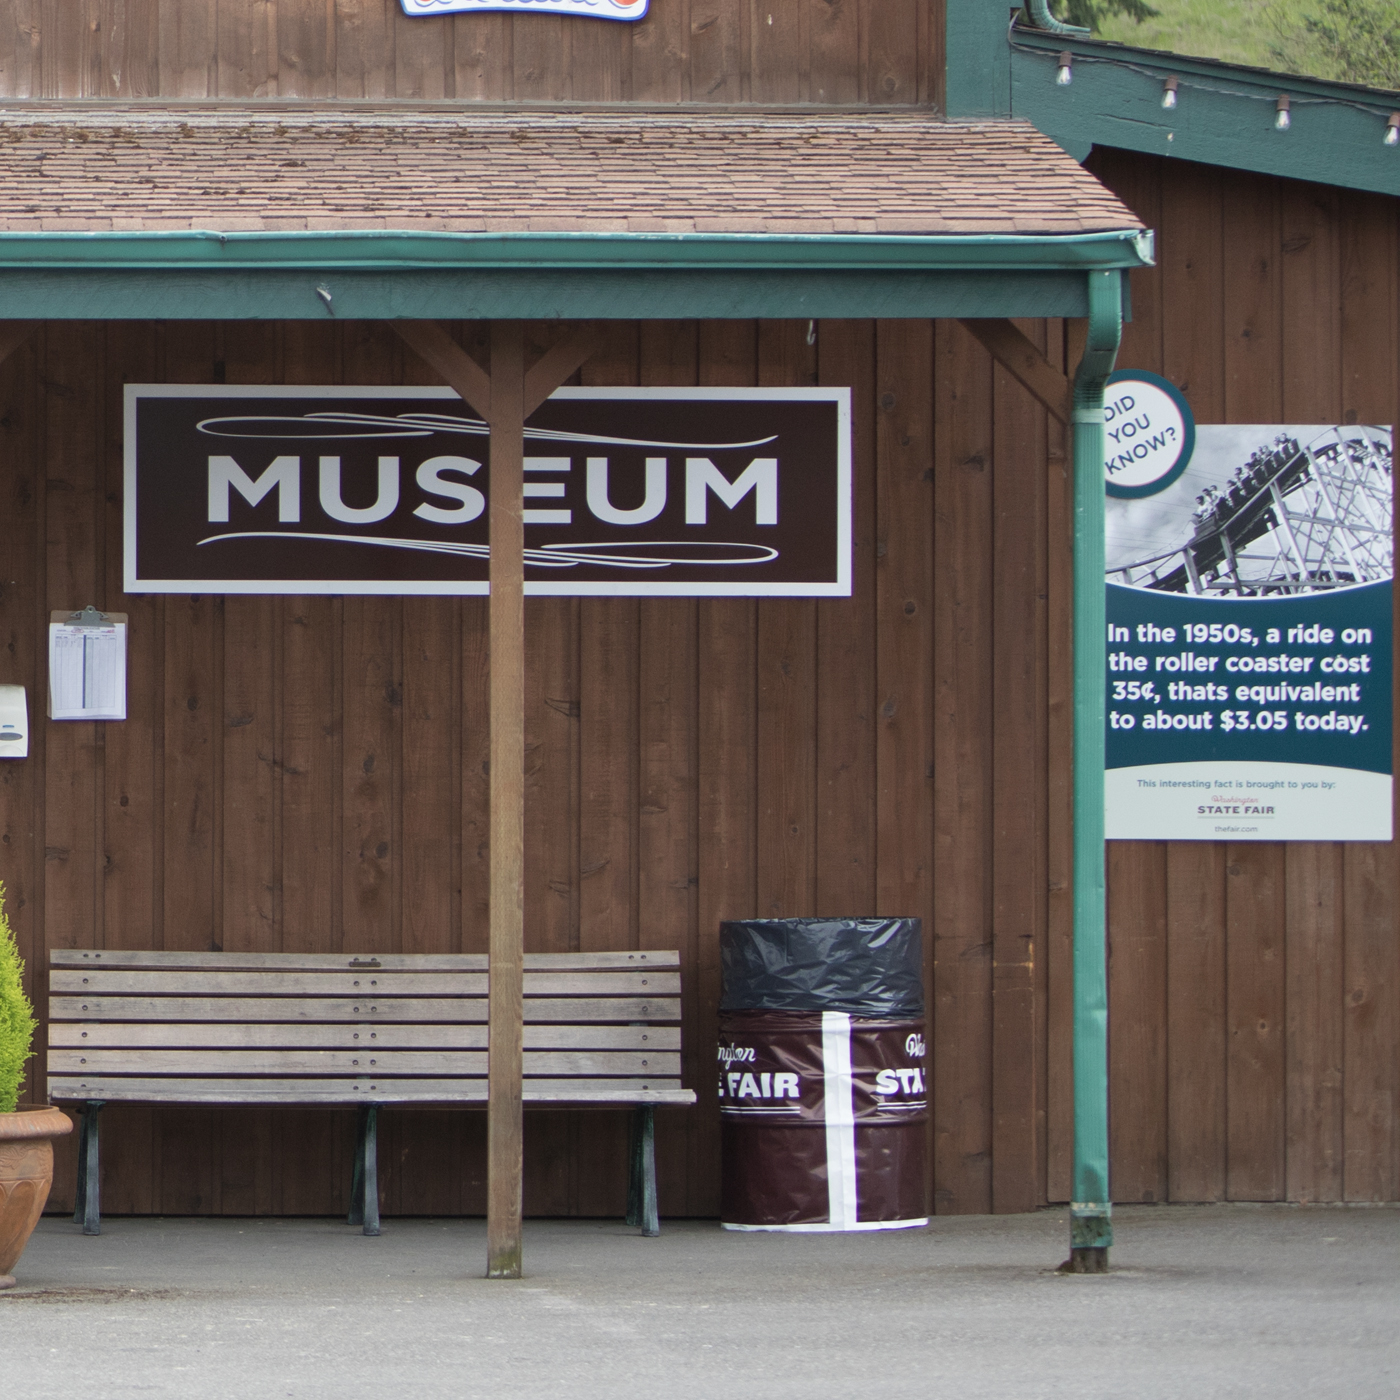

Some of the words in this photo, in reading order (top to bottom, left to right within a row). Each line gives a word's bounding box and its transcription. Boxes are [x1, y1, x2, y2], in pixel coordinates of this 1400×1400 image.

[1104, 395, 1135, 423] DID
[1107, 413, 1150, 444] YOU
[1104, 426, 1176, 475] KNOW?
[207, 455, 778, 525] MUSEUM
[1107, 623, 1129, 642] In
[1136, 623, 1176, 642] the
[1183, 624, 1259, 647] 1950s,
[1265, 628, 1280, 643] a
[1287, 624, 1334, 643] ride
[1341, 628, 1372, 643] on
[1108, 652, 1148, 672] the
[1155, 652, 1219, 672] roller
[1225, 653, 1314, 673] coaster
[1320, 654, 1371, 673] cost
[1112, 681, 1161, 704] 35¢,
[1168, 681, 1228, 701] thats
[1235, 682, 1360, 705] equivalent
[1110, 711, 1135, 730] to
[1142, 710, 1213, 730] about
[1220, 710, 1287, 732] $3.05
[1295, 710, 1368, 734] today.
[1137, 779, 1157, 788] This
[1159, 779, 1211, 789] interesting
[1214, 780, 1232, 788] fact
[1235, 780, 1243, 788] is
[1247, 780, 1284, 789] brought
[1300, 781, 1318, 789] you
[1197, 806, 1240, 814] STATE
[1245, 806, 1275, 814] FAIR
[1214, 825, 1258, 833] thefair.com
[727, 1072, 800, 1098] FAIR
